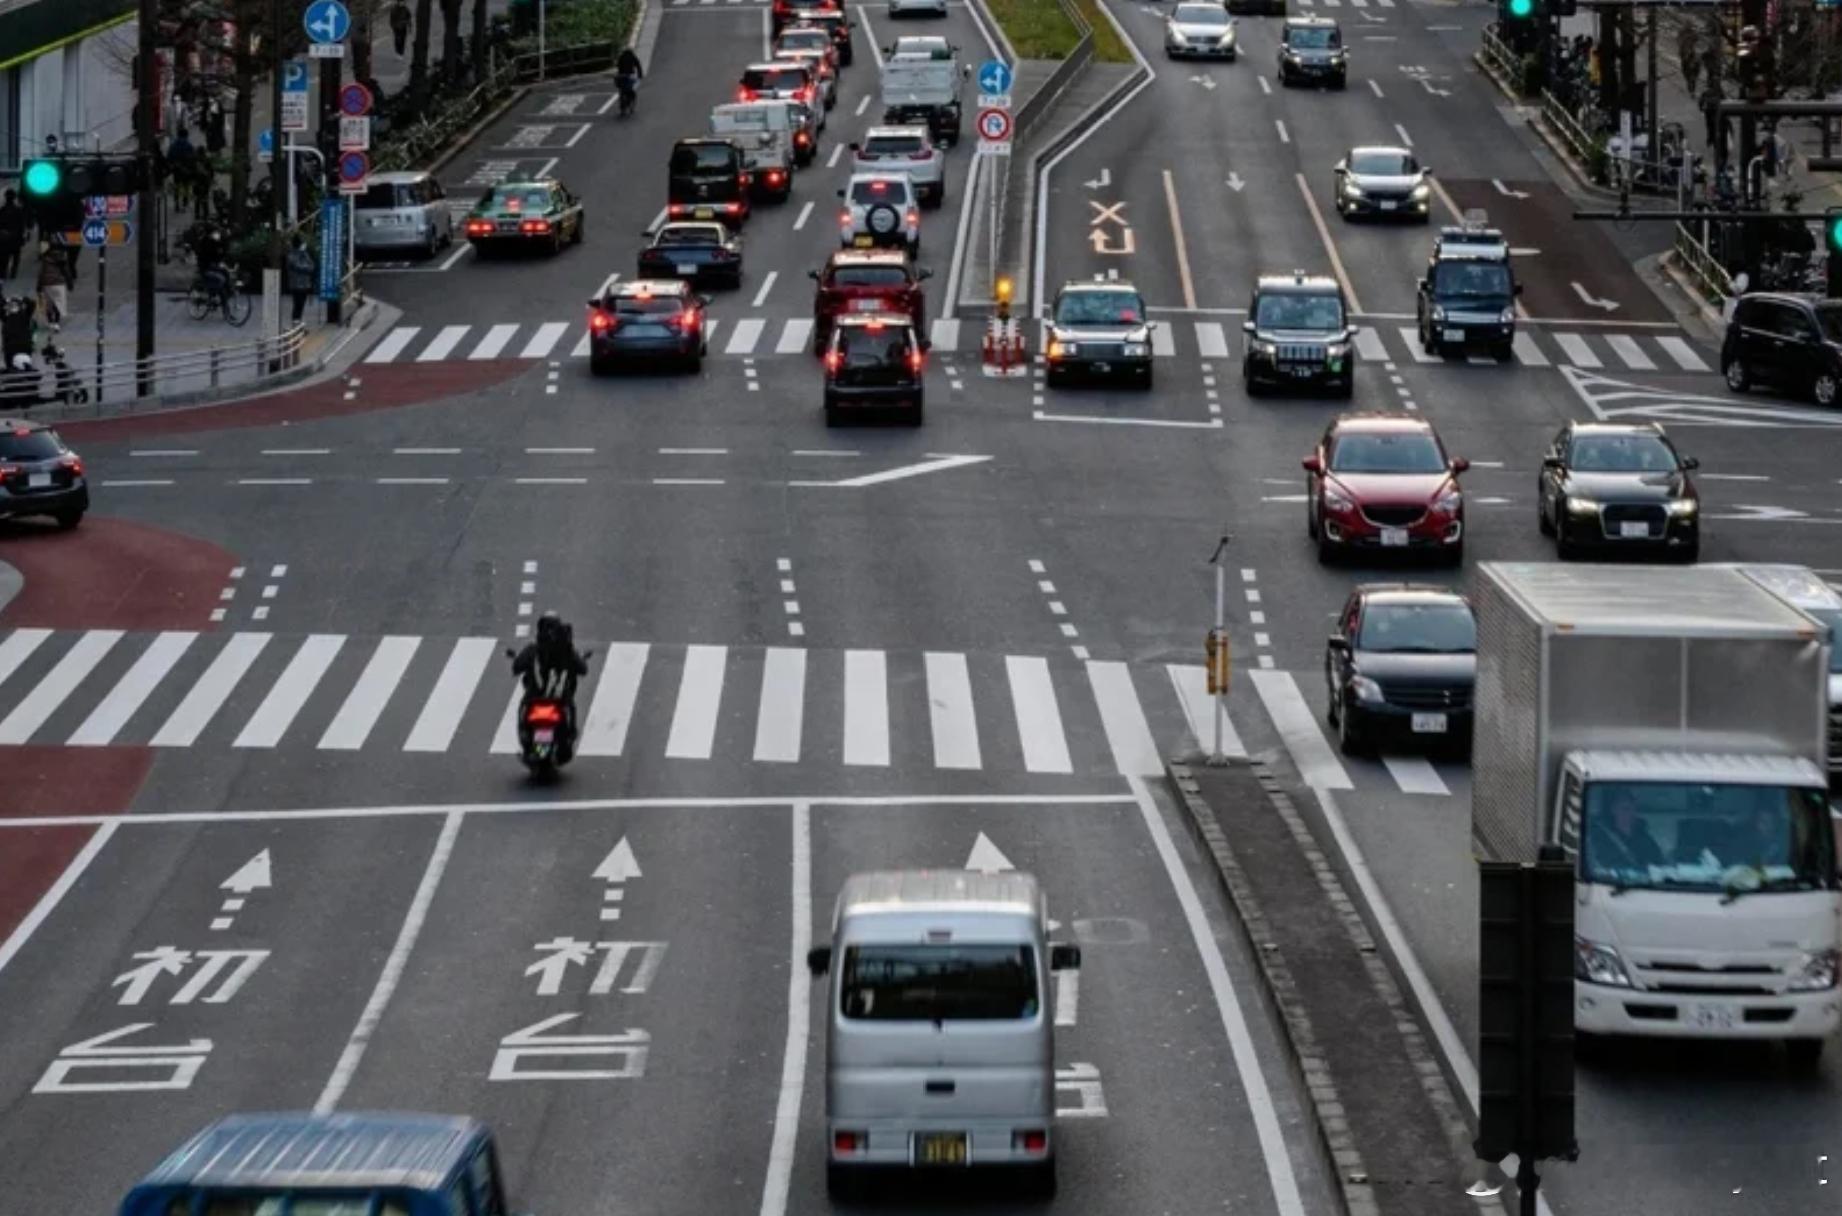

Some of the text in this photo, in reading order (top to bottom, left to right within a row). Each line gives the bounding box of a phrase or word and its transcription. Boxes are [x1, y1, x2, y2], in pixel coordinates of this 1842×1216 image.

[285, 64, 302, 88] P
[32, 946, 271, 1093] 初台
[488, 937, 667, 1080] 初台
